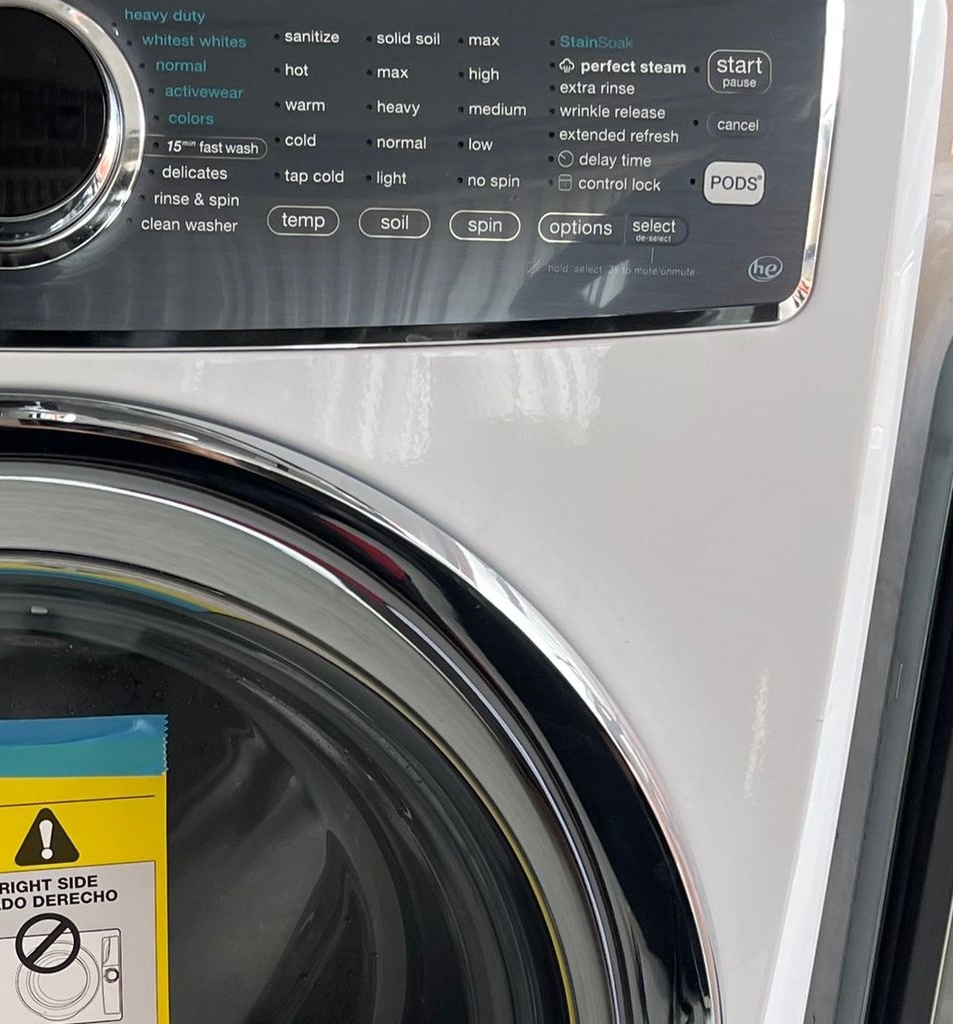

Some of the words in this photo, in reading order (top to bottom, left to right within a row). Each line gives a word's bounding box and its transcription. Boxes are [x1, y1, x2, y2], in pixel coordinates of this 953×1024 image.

[125, 9, 168, 24] heavy
[173, 9, 206, 24] duty
[142, 34, 196, 47] whitest
[199, 36, 246, 48] whites
[284, 30, 340, 43] sanitize
[376, 32, 411, 46] solid
[415, 32, 440, 46] soil
[468, 35, 499, 46] max
[559, 35, 634, 48] StainSoak
[155, 59, 207, 72] normal
[285, 63, 309, 77] hot
[580, 60, 637, 76] perfect
[640, 62, 687, 74] steam
[716, 56, 763, 74] start
[377, 67, 409, 79] max
[468, 68, 499, 83] high
[559, 82, 596, 95] extra
[599, 82, 635, 96] rinse
[722, 77, 757, 89] pause
[165, 85, 244, 99] activewear
[285, 100, 325, 112] warm
[376, 101, 420, 116] heavy
[469, 103, 527, 116] medium
[559, 105, 611, 118] wrinkle
[614, 106, 666, 119] release
[168, 112, 214, 125] colors
[717, 118, 759, 131] cancel
[285, 134, 316, 147] cold
[376, 137, 427, 149] normal
[559, 129, 626, 142] extended
[630, 130, 679, 144] refresh
[199, 141, 223, 153] fast
[225, 142, 259, 154] wash
[468, 138, 493, 151] low
[579, 153, 618, 170] delay
[621, 154, 652, 167] time
[162, 166, 228, 180] delicates
[284, 171, 308, 184] tap
[312, 171, 344, 183] cold
[376, 171, 407, 186] light
[467, 176, 486, 188] no
[490, 175, 520, 189] spin
[578, 178, 628, 191] control
[631, 178, 661, 192] lock
[154, 193, 190, 205] rinse
[194, 193, 205, 206] &
[209, 193, 239, 208] spin
[141, 218, 180, 231] clean
[185, 219, 238, 232] washer
[281, 213, 325, 229] temp
[380, 216, 409, 230] soil
[468, 218, 503, 233] spin
[549, 220, 613, 236] options
[632, 219, 676, 233] select
[635, 234, 672, 243] de-select
[752, 260, 777, 276] he
[57, 875, 98, 890] SIDE
[33, 889, 118, 908] DERECHO
